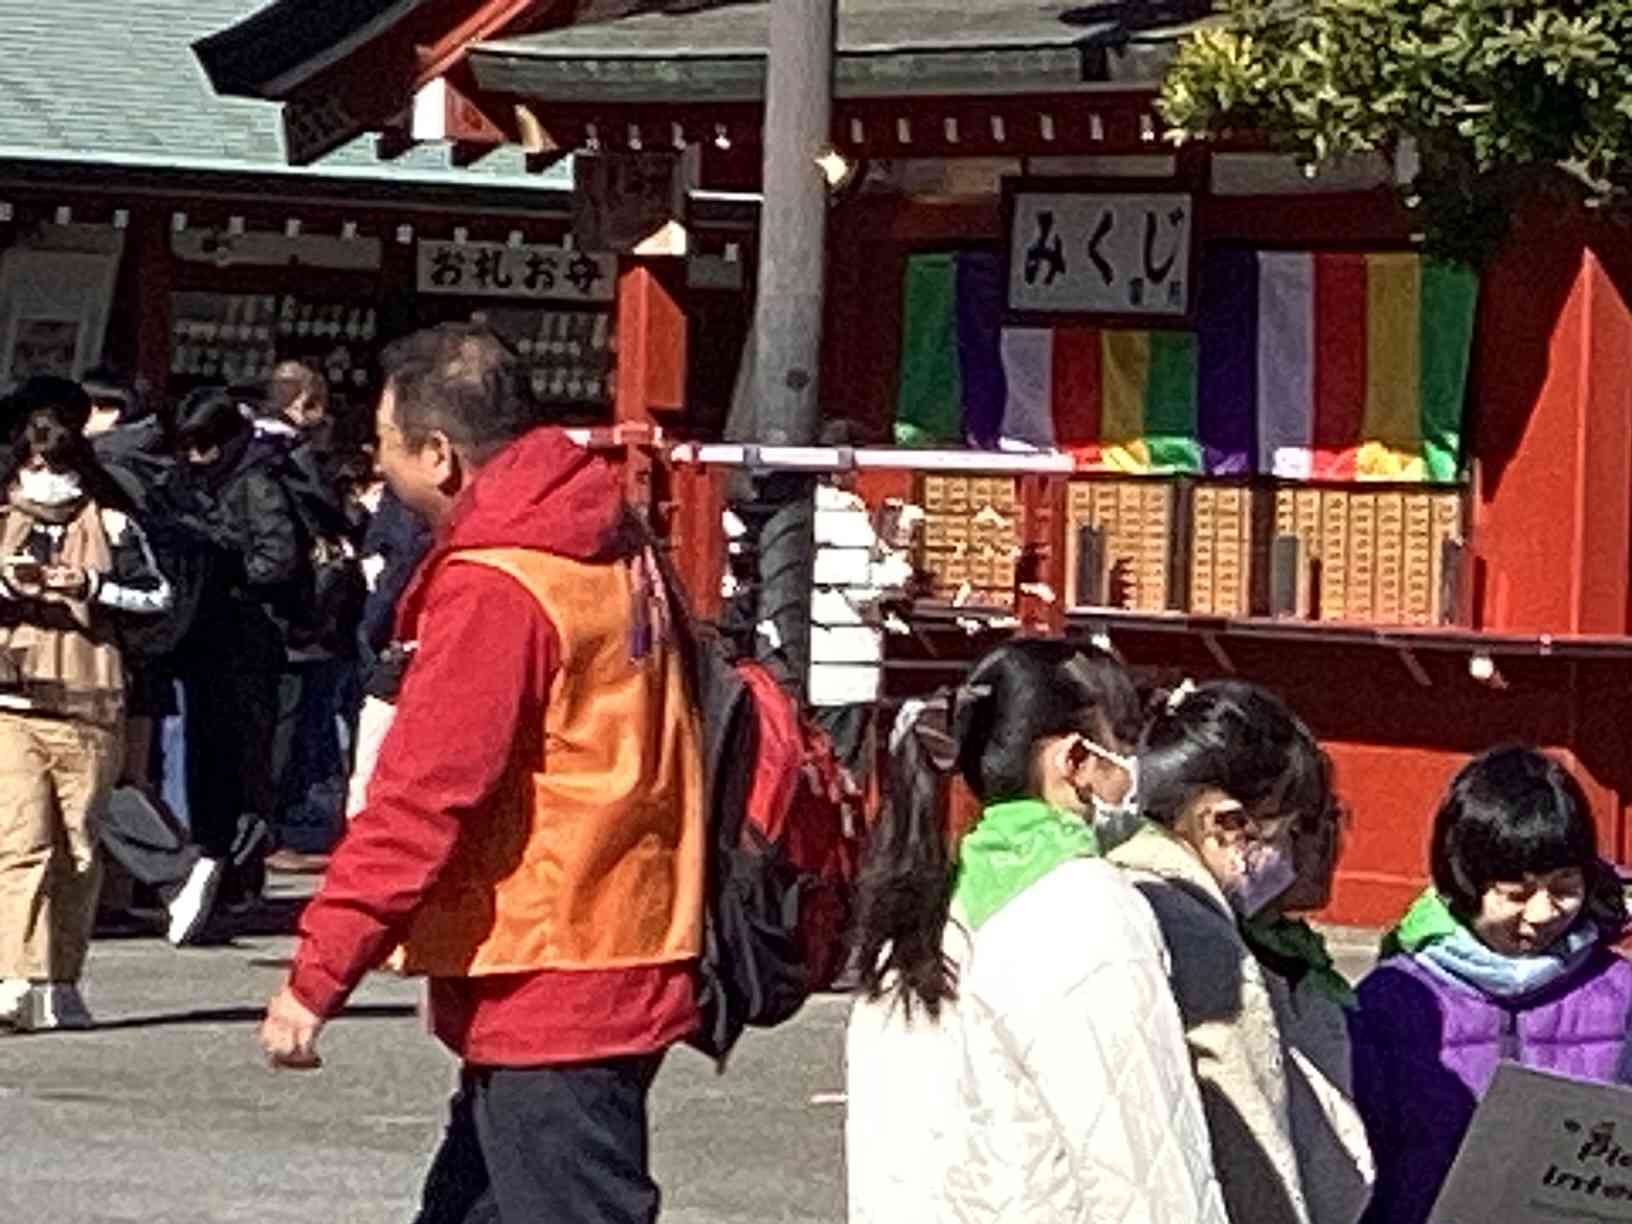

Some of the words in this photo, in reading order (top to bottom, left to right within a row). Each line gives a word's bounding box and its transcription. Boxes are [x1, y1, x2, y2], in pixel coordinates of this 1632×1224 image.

[430, 248, 604, 294] お札お守
[1024, 206, 1186, 286] みくじ
